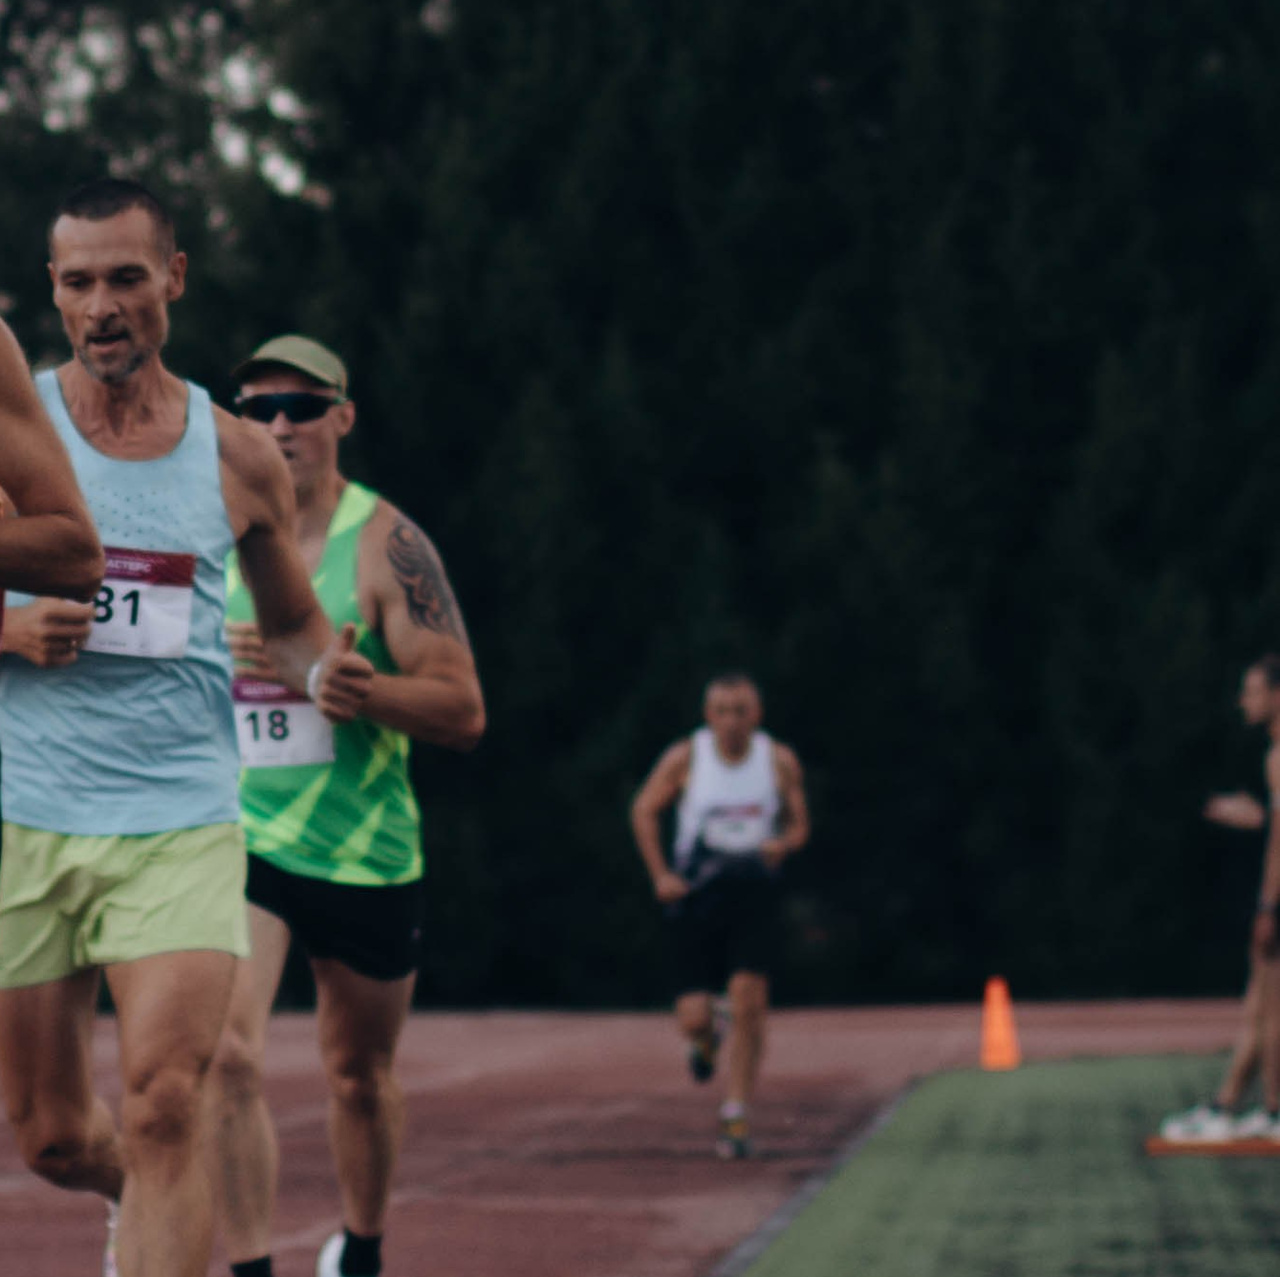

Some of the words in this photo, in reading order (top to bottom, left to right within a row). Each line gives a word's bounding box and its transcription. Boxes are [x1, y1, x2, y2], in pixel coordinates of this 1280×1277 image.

[105, 558, 152, 572] АСТЕРС
[93, 585, 140, 626] 81
[244, 709, 289, 741] 18
